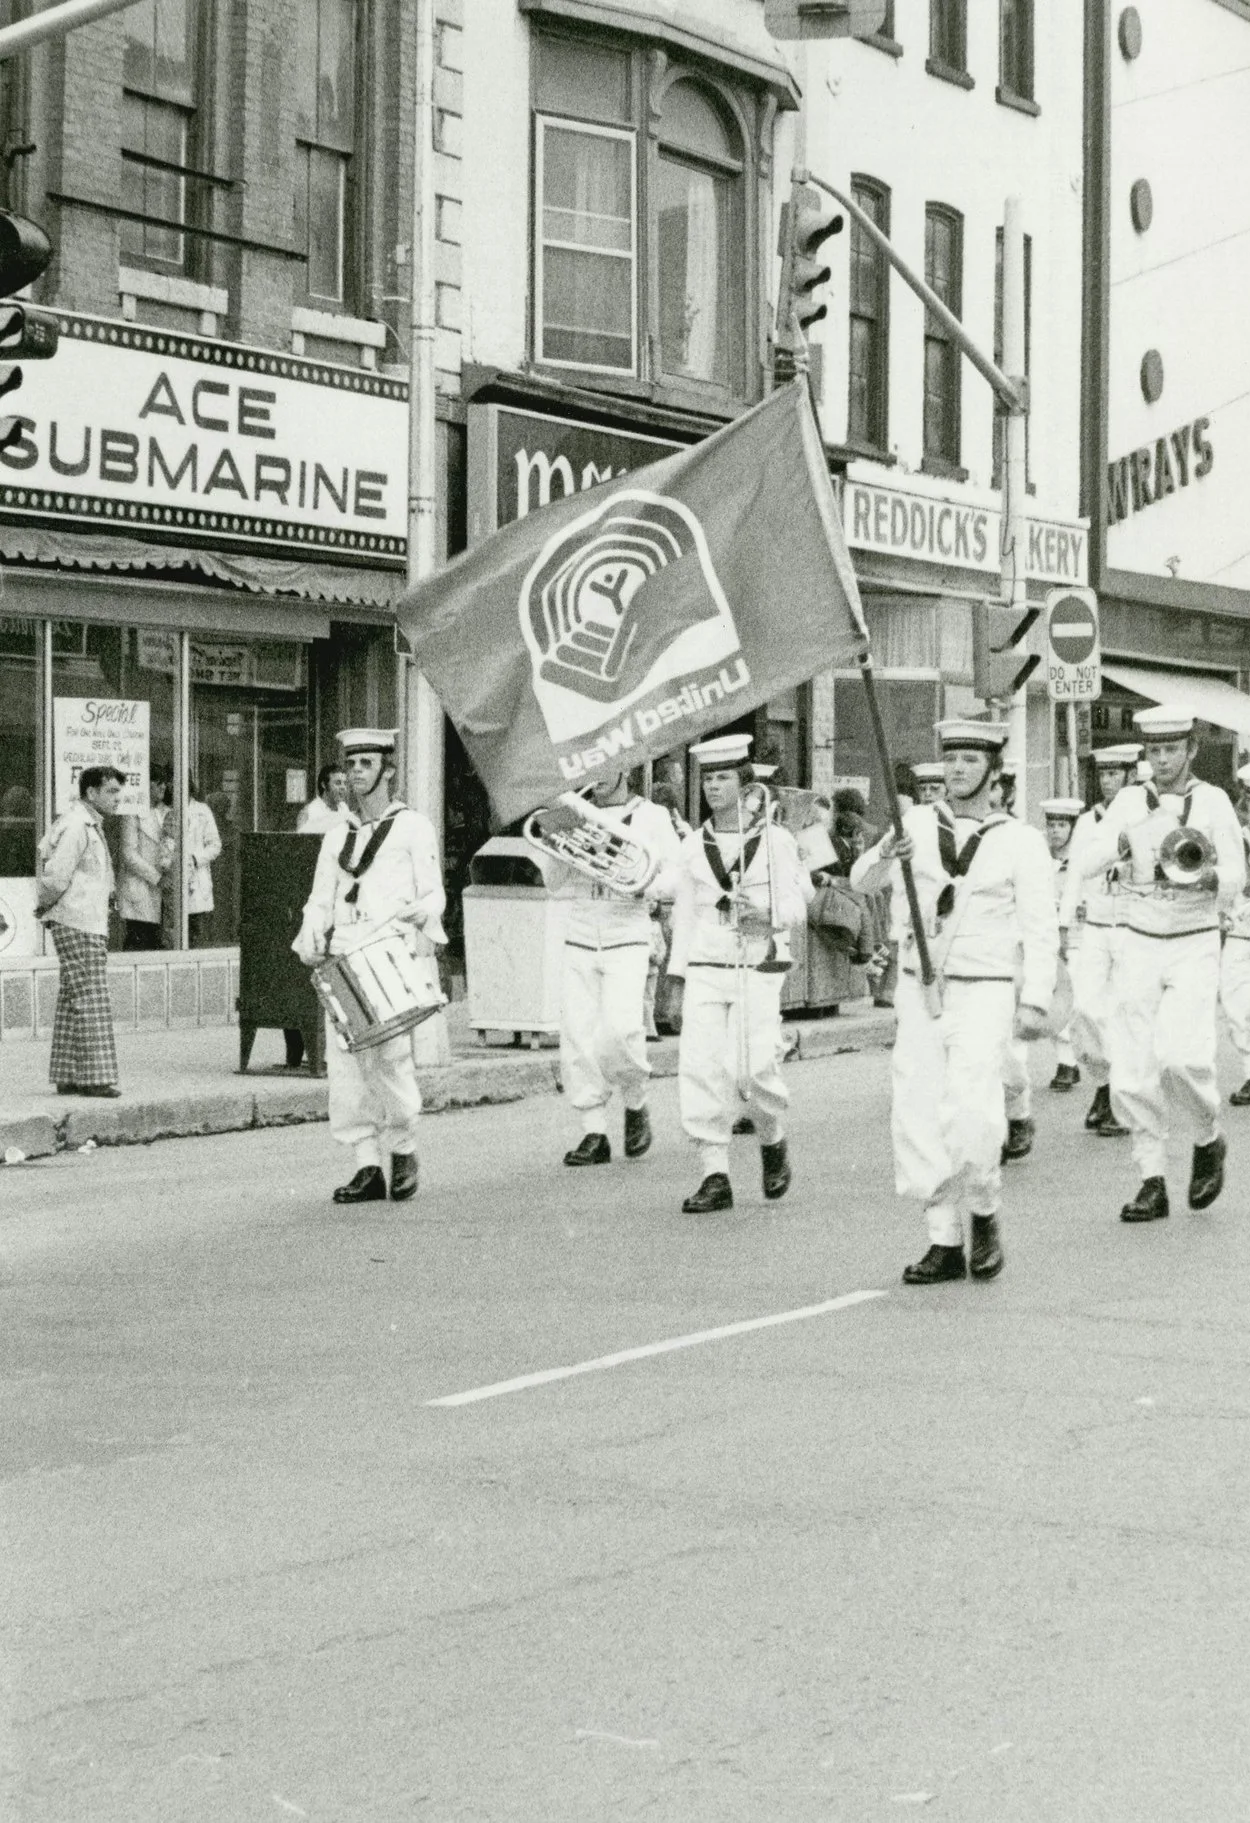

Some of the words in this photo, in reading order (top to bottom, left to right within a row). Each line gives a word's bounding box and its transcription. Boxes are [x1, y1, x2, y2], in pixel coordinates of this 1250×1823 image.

[139, 372, 277, 440] ACE
[0, 415, 389, 520] SUBMARINE
[1108, 417, 1214, 526] WRAYS
[853, 488, 988, 563] REDDICK'S
[1027, 524, 1083, 579] KERY
[1049, 666, 1065, 680] DO
[1076, 665, 1098, 680] NOT
[1055, 680, 1094, 694] ENTER
[81, 701, 137, 727] Special
